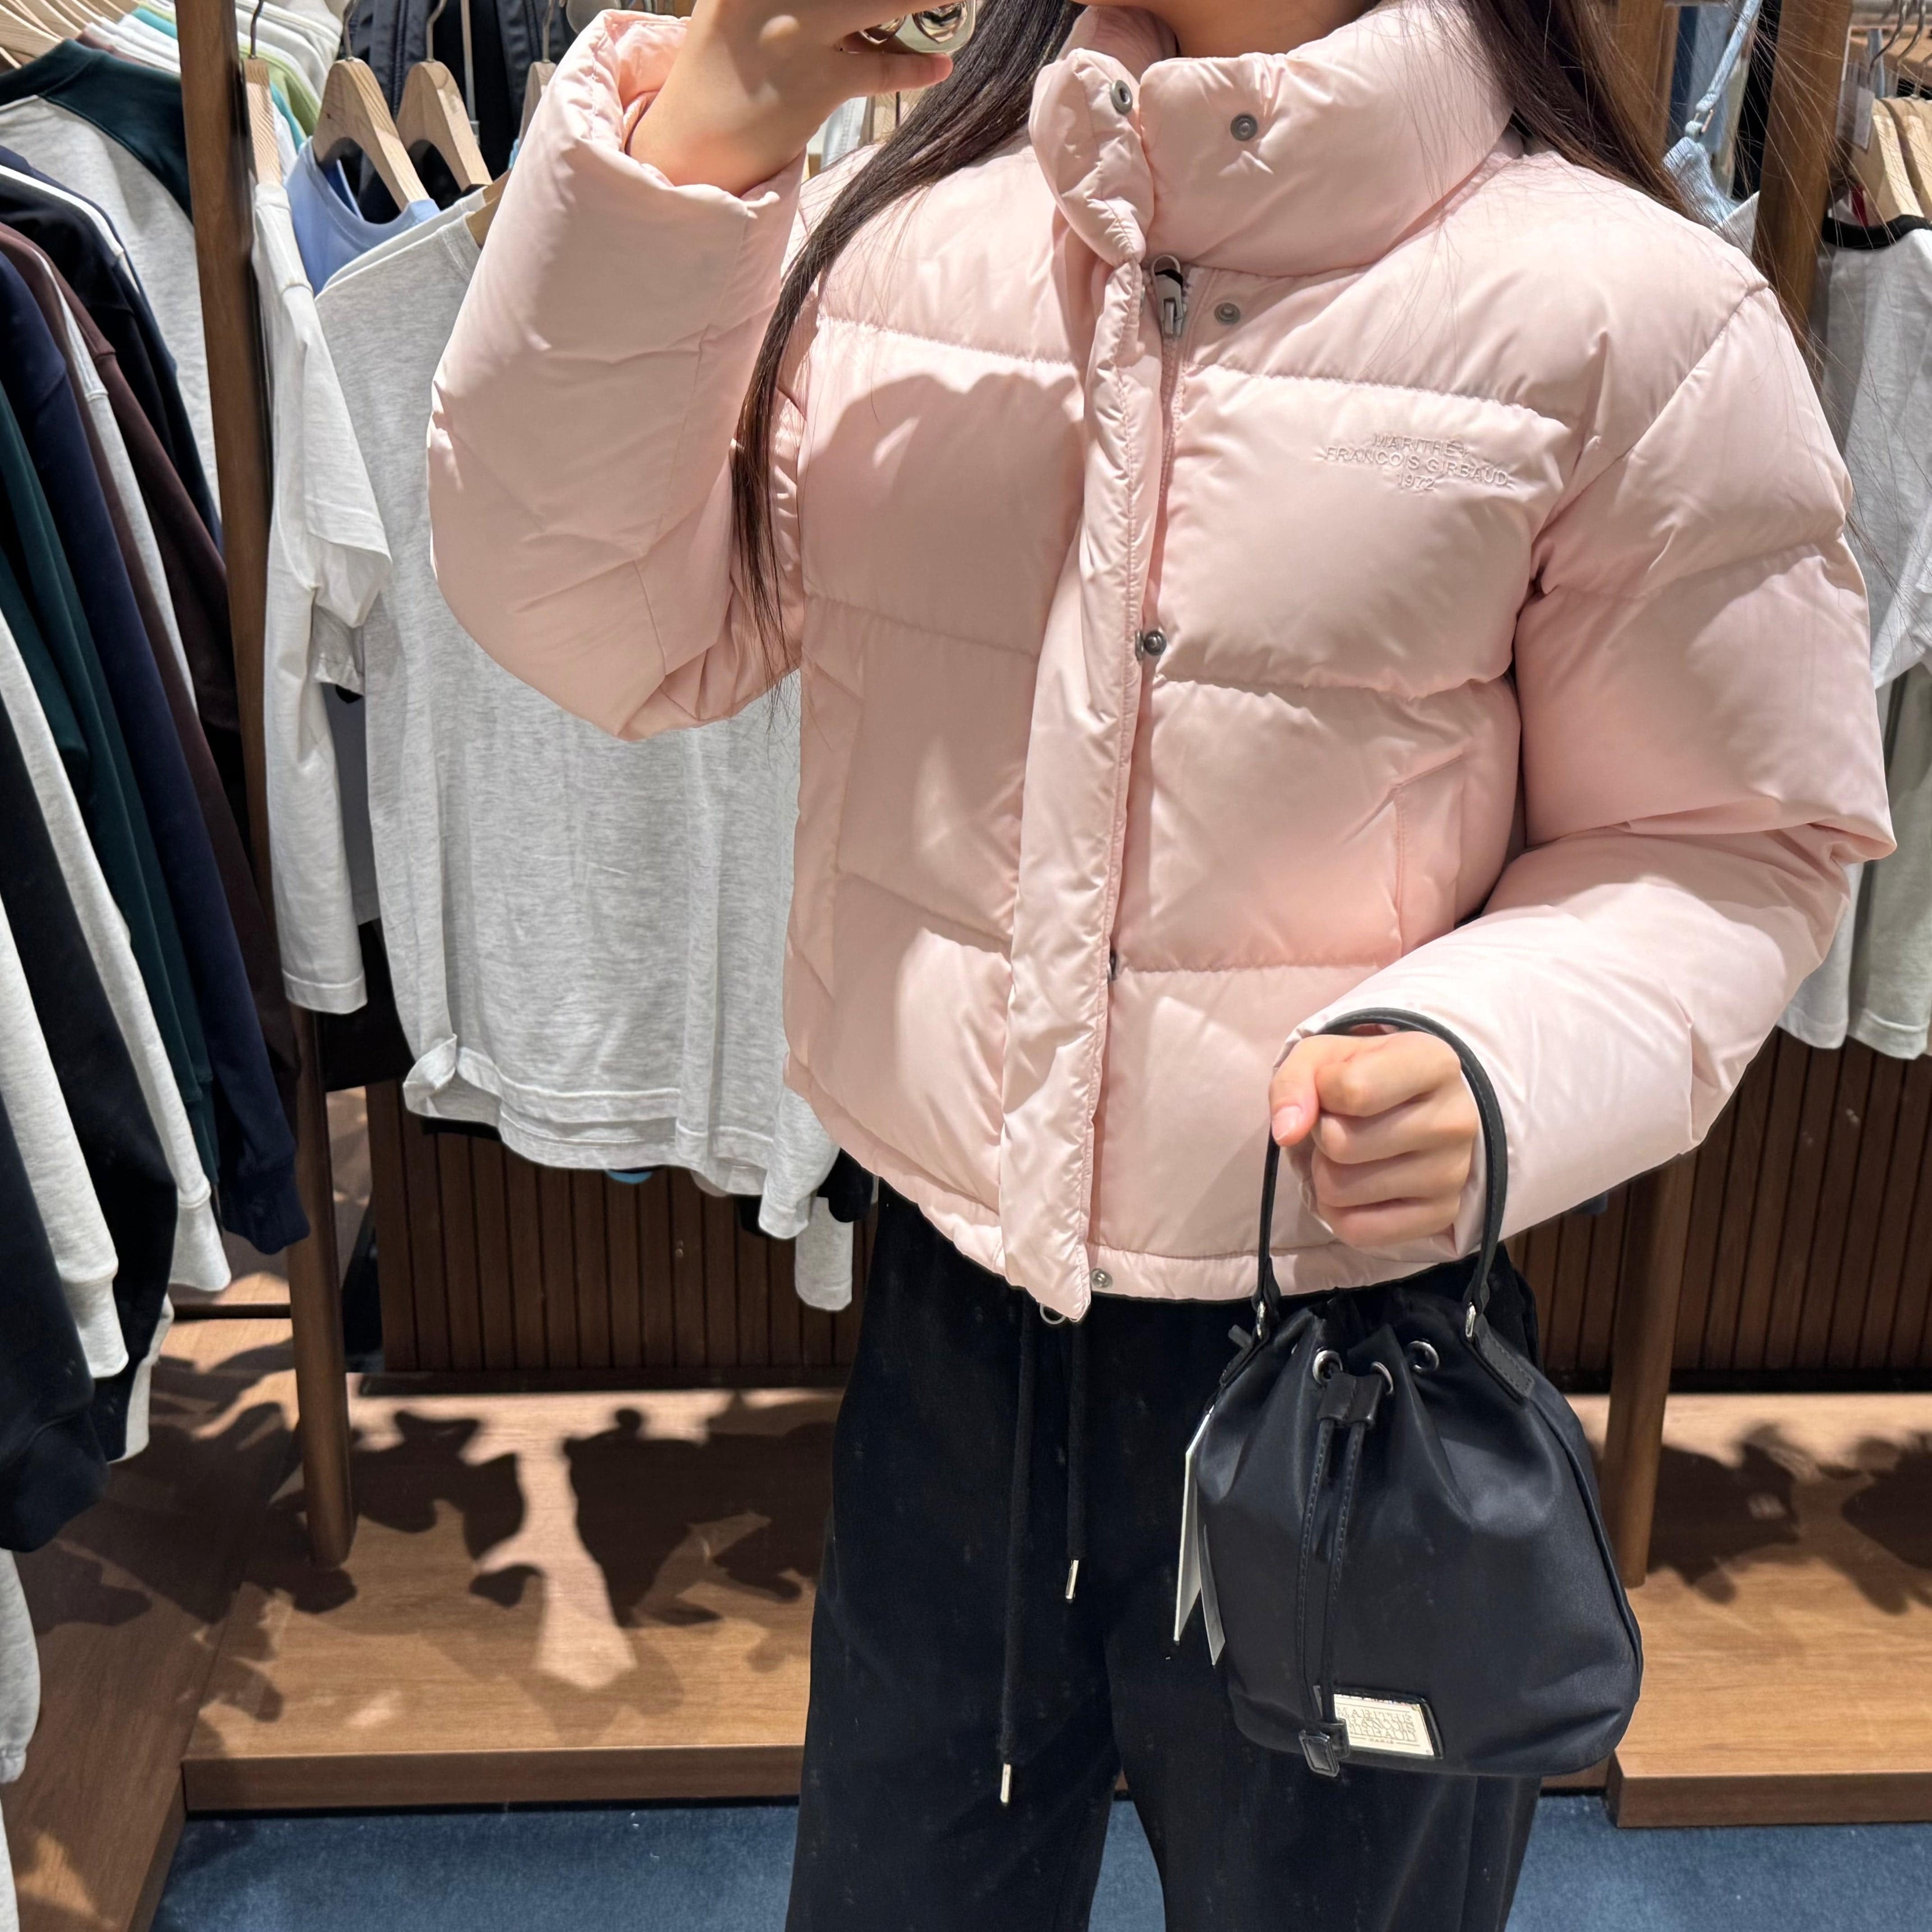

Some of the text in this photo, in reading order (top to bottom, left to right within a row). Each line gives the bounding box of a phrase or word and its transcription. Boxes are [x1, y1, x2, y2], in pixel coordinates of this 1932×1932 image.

[1325, 447, 1508, 486] FRANCOIS GIRBAUD
[1397, 471, 1435, 490] 1972
